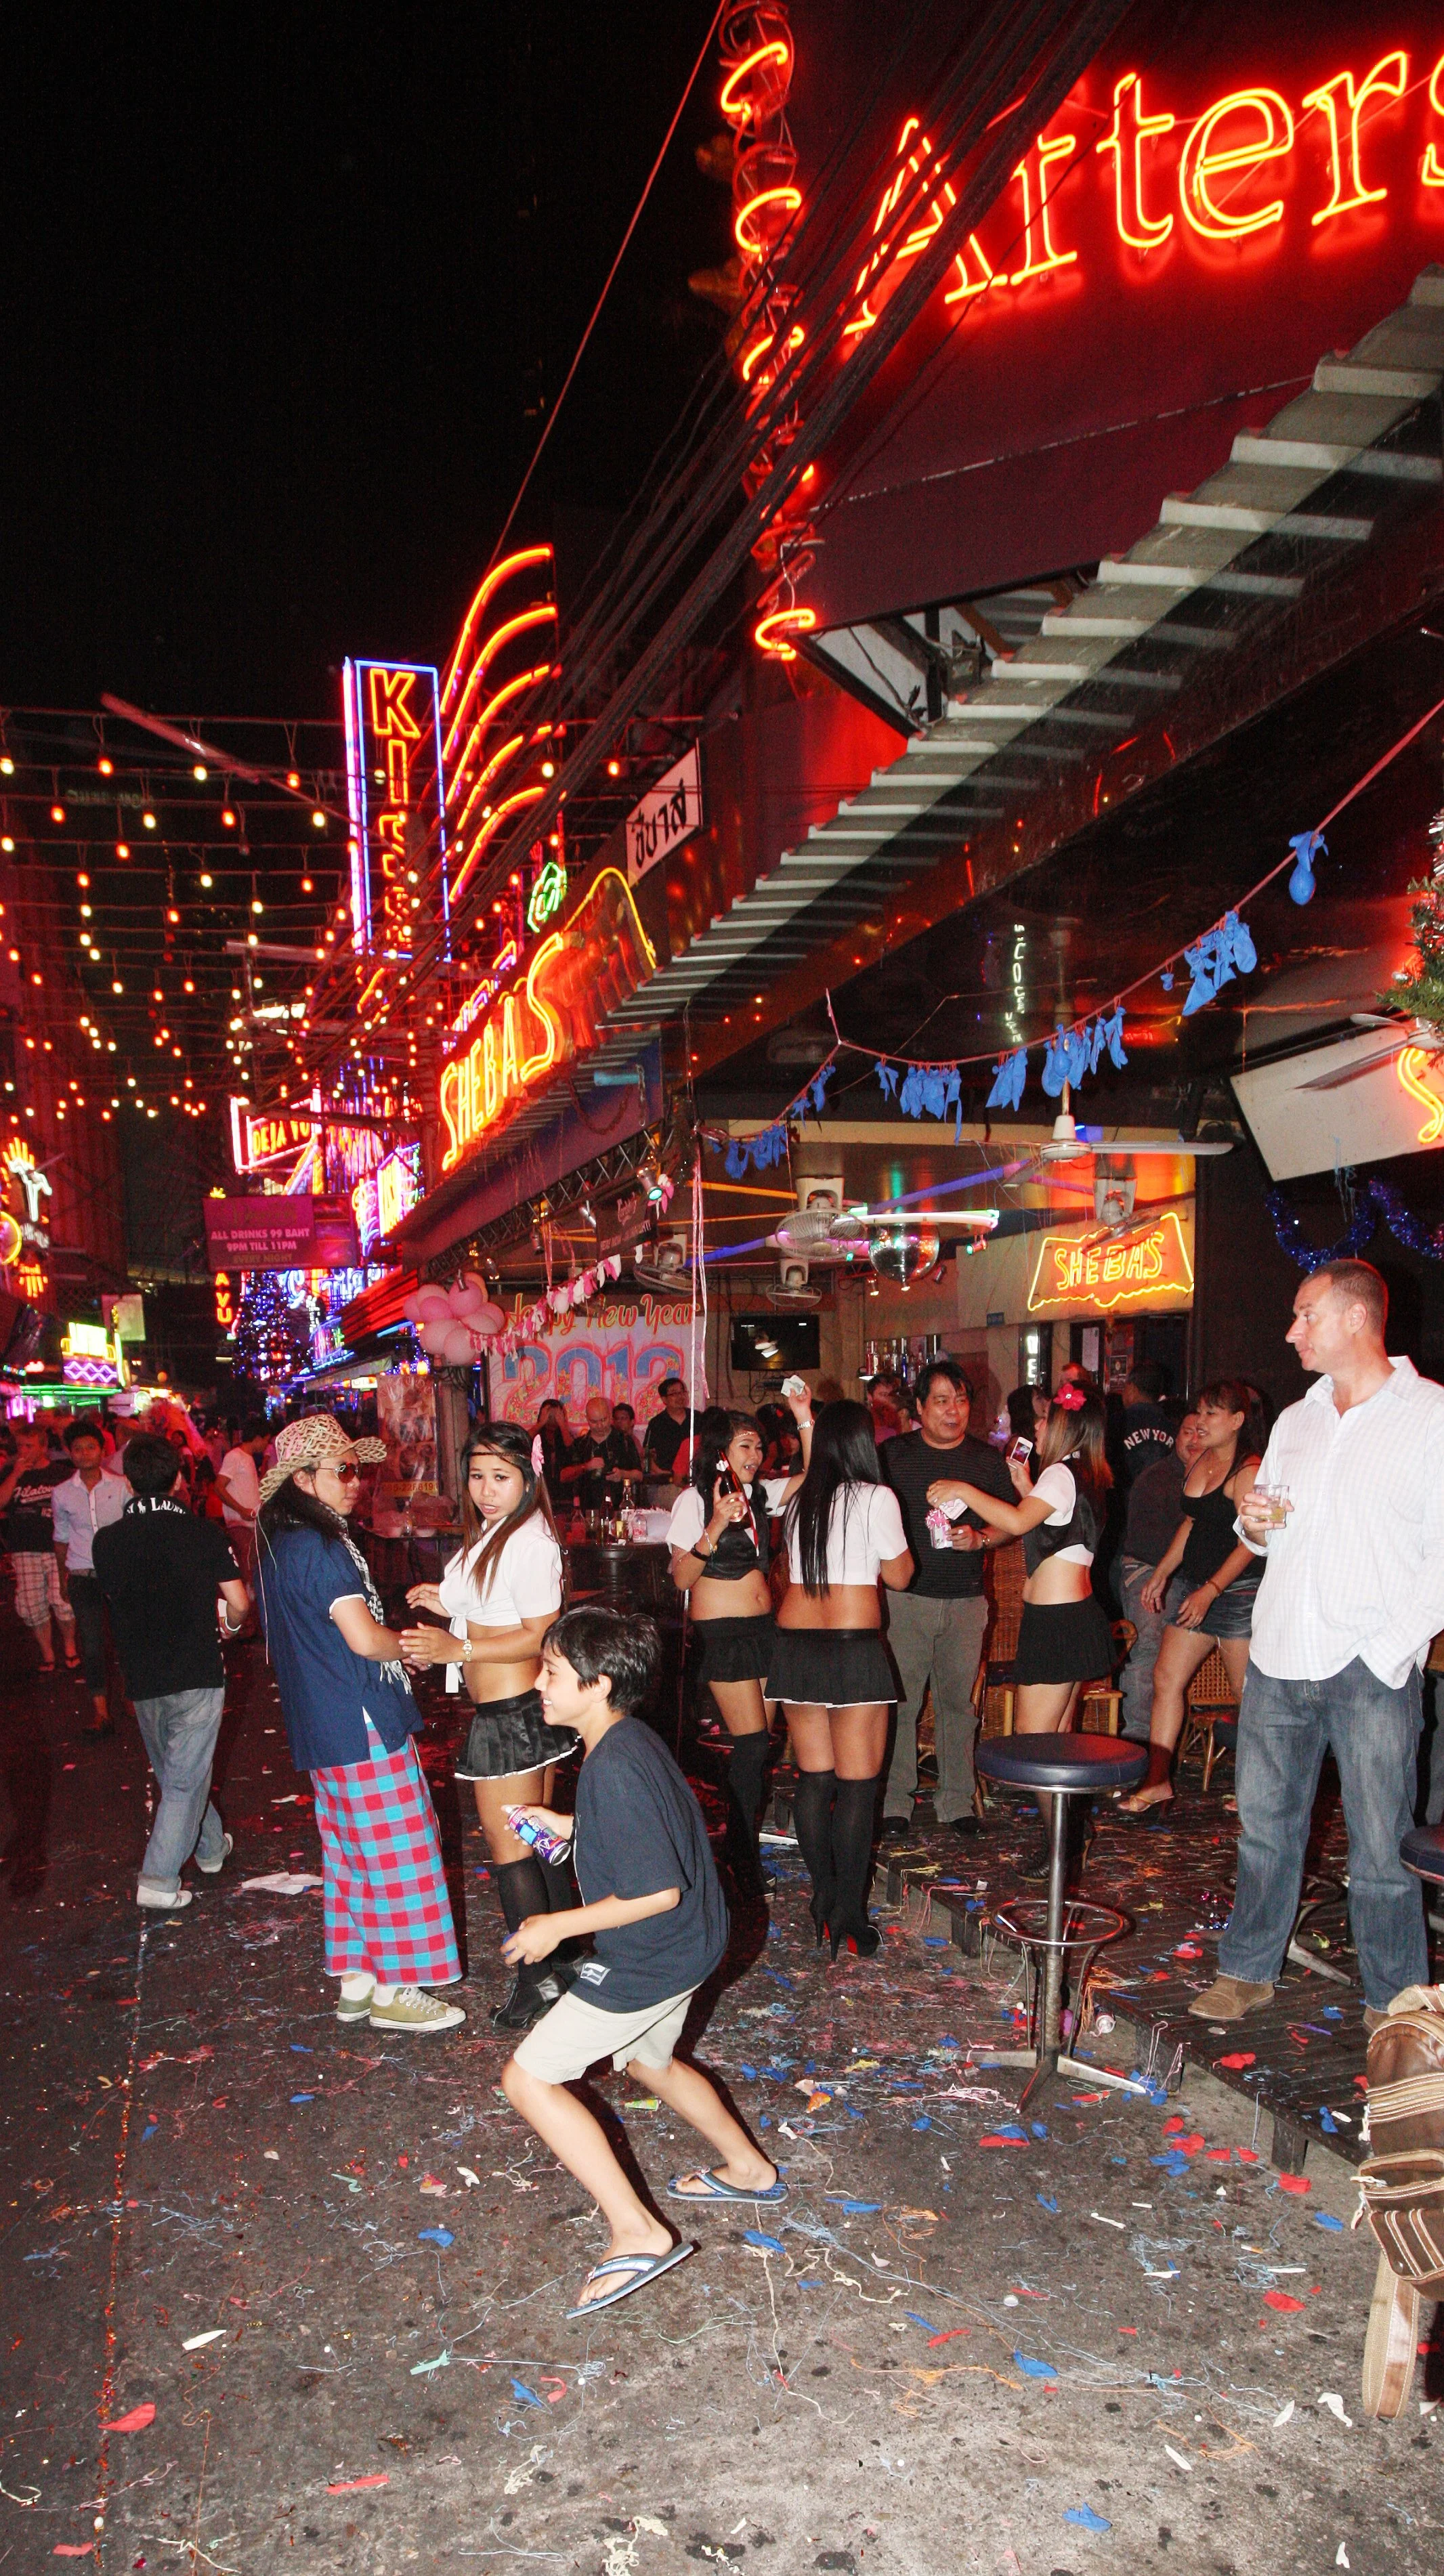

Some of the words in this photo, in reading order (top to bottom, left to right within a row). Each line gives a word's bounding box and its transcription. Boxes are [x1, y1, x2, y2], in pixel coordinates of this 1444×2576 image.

[844, 49, 1444, 336] After
[253, 1121, 287, 1157] DEJA
[211, 1230, 229, 1240] ALL
[230, 1228, 268, 1240] DRINKS
[270, 1228, 282, 1239] 99
[284, 1228, 310, 1238] BAHT
[227, 1242, 248, 1252] 9PM
[249, 1241, 269, 1251] TILL
[270, 1240, 297, 1250] 11PM
[263, 1253, 292, 1263] NIGHT
[639, 1293, 700, 1335] Year
[501, 1338, 686, 1426] 2012
[1123, 1427, 1151, 1451] NEW
[1151, 1429, 1174, 1448] YOR
[150, 1497, 186, 1515] LAUR
